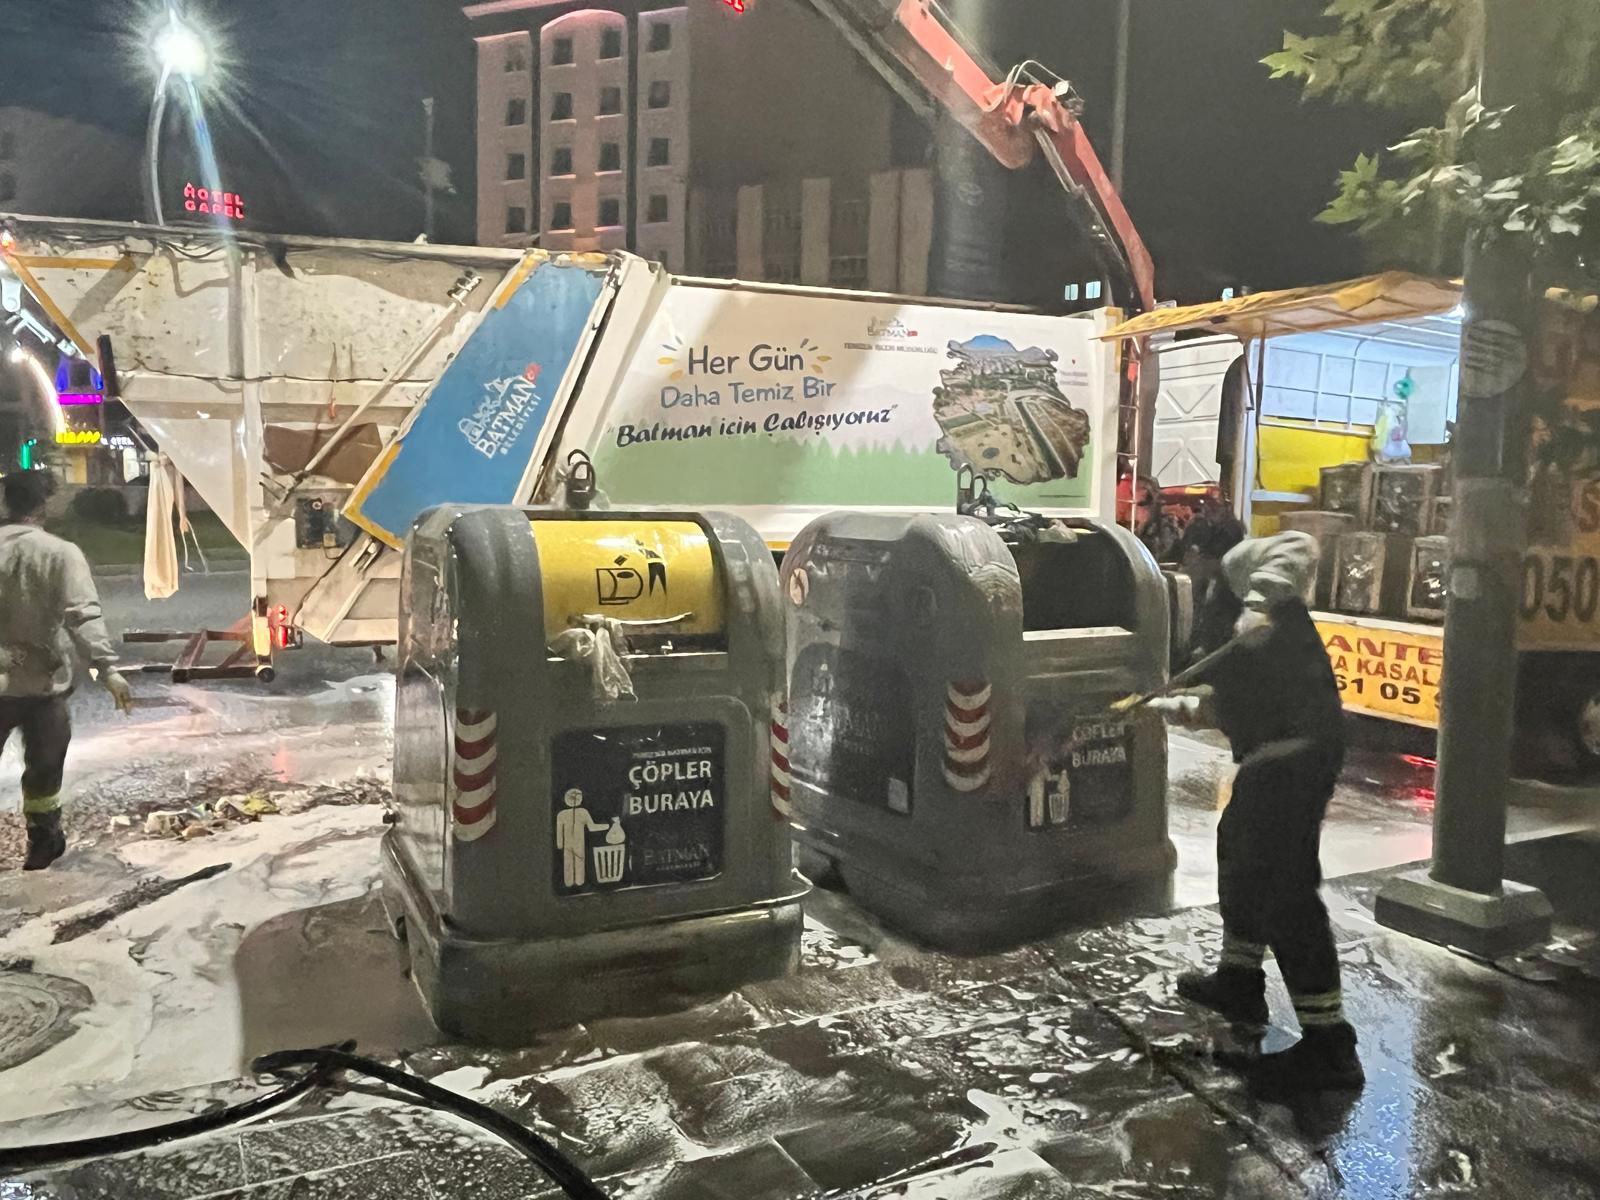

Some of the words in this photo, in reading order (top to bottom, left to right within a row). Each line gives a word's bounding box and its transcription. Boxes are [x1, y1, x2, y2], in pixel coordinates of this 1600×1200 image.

[688, 345, 739, 375] Her
[749, 346, 804, 372] Gün
[660, 384, 721, 409] Daha
[728, 381, 795, 405] Temiz
[803, 376, 836, 399] Bir
[474, 376, 537, 460] BATMAN
[1357, 657, 1442, 687] KASAL
[1379, 682, 1421, 705] 05
[628, 760, 712, 790] ÇÖPLER
[629, 789, 714, 815] BURAYA
